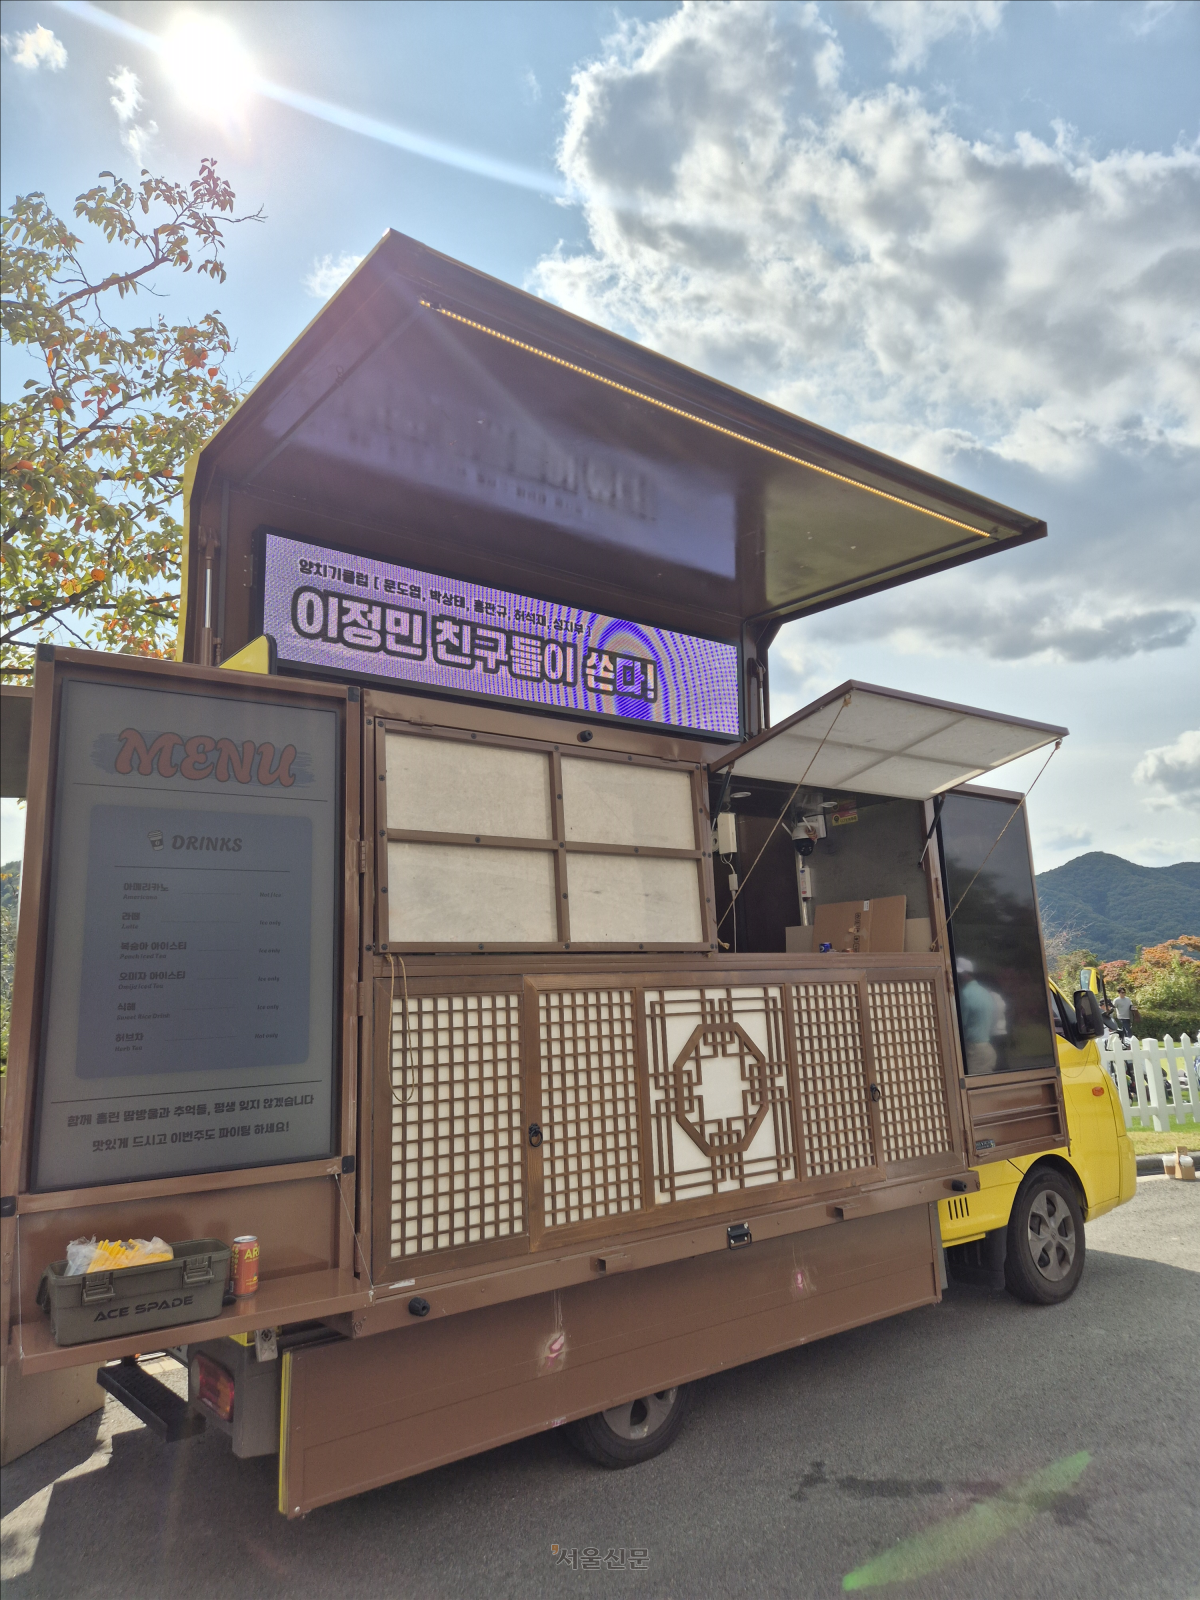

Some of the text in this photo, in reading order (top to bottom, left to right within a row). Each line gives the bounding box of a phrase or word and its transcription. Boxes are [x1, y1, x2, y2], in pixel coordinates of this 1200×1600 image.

[298, 558, 369, 588] 양치기클럽
[384, 578, 426, 602] 문도엽,
[430, 589, 469, 612] 박상태,
[291, 585, 658, 704] 이정민 친구들이 쏜다!
[115, 727, 297, 787] MENU
[171, 834, 243, 852] DRINKS
[123, 882, 169, 892] 아메리카노
[120, 941, 187, 951] 복숭아 아이스티
[118, 970, 186, 981] 오미자 아이스티
[115, 1032, 144, 1042] 허브차
[67, 1094, 315, 1127] 함께 흘린 땀방울과 추억들, 평생 잊지 않겠습니다
[92, 1121, 290, 1152] 맛있게 드시고 이번주도 파이팅 하세요!
[94, 1295, 194, 1322] ACE SPADE
